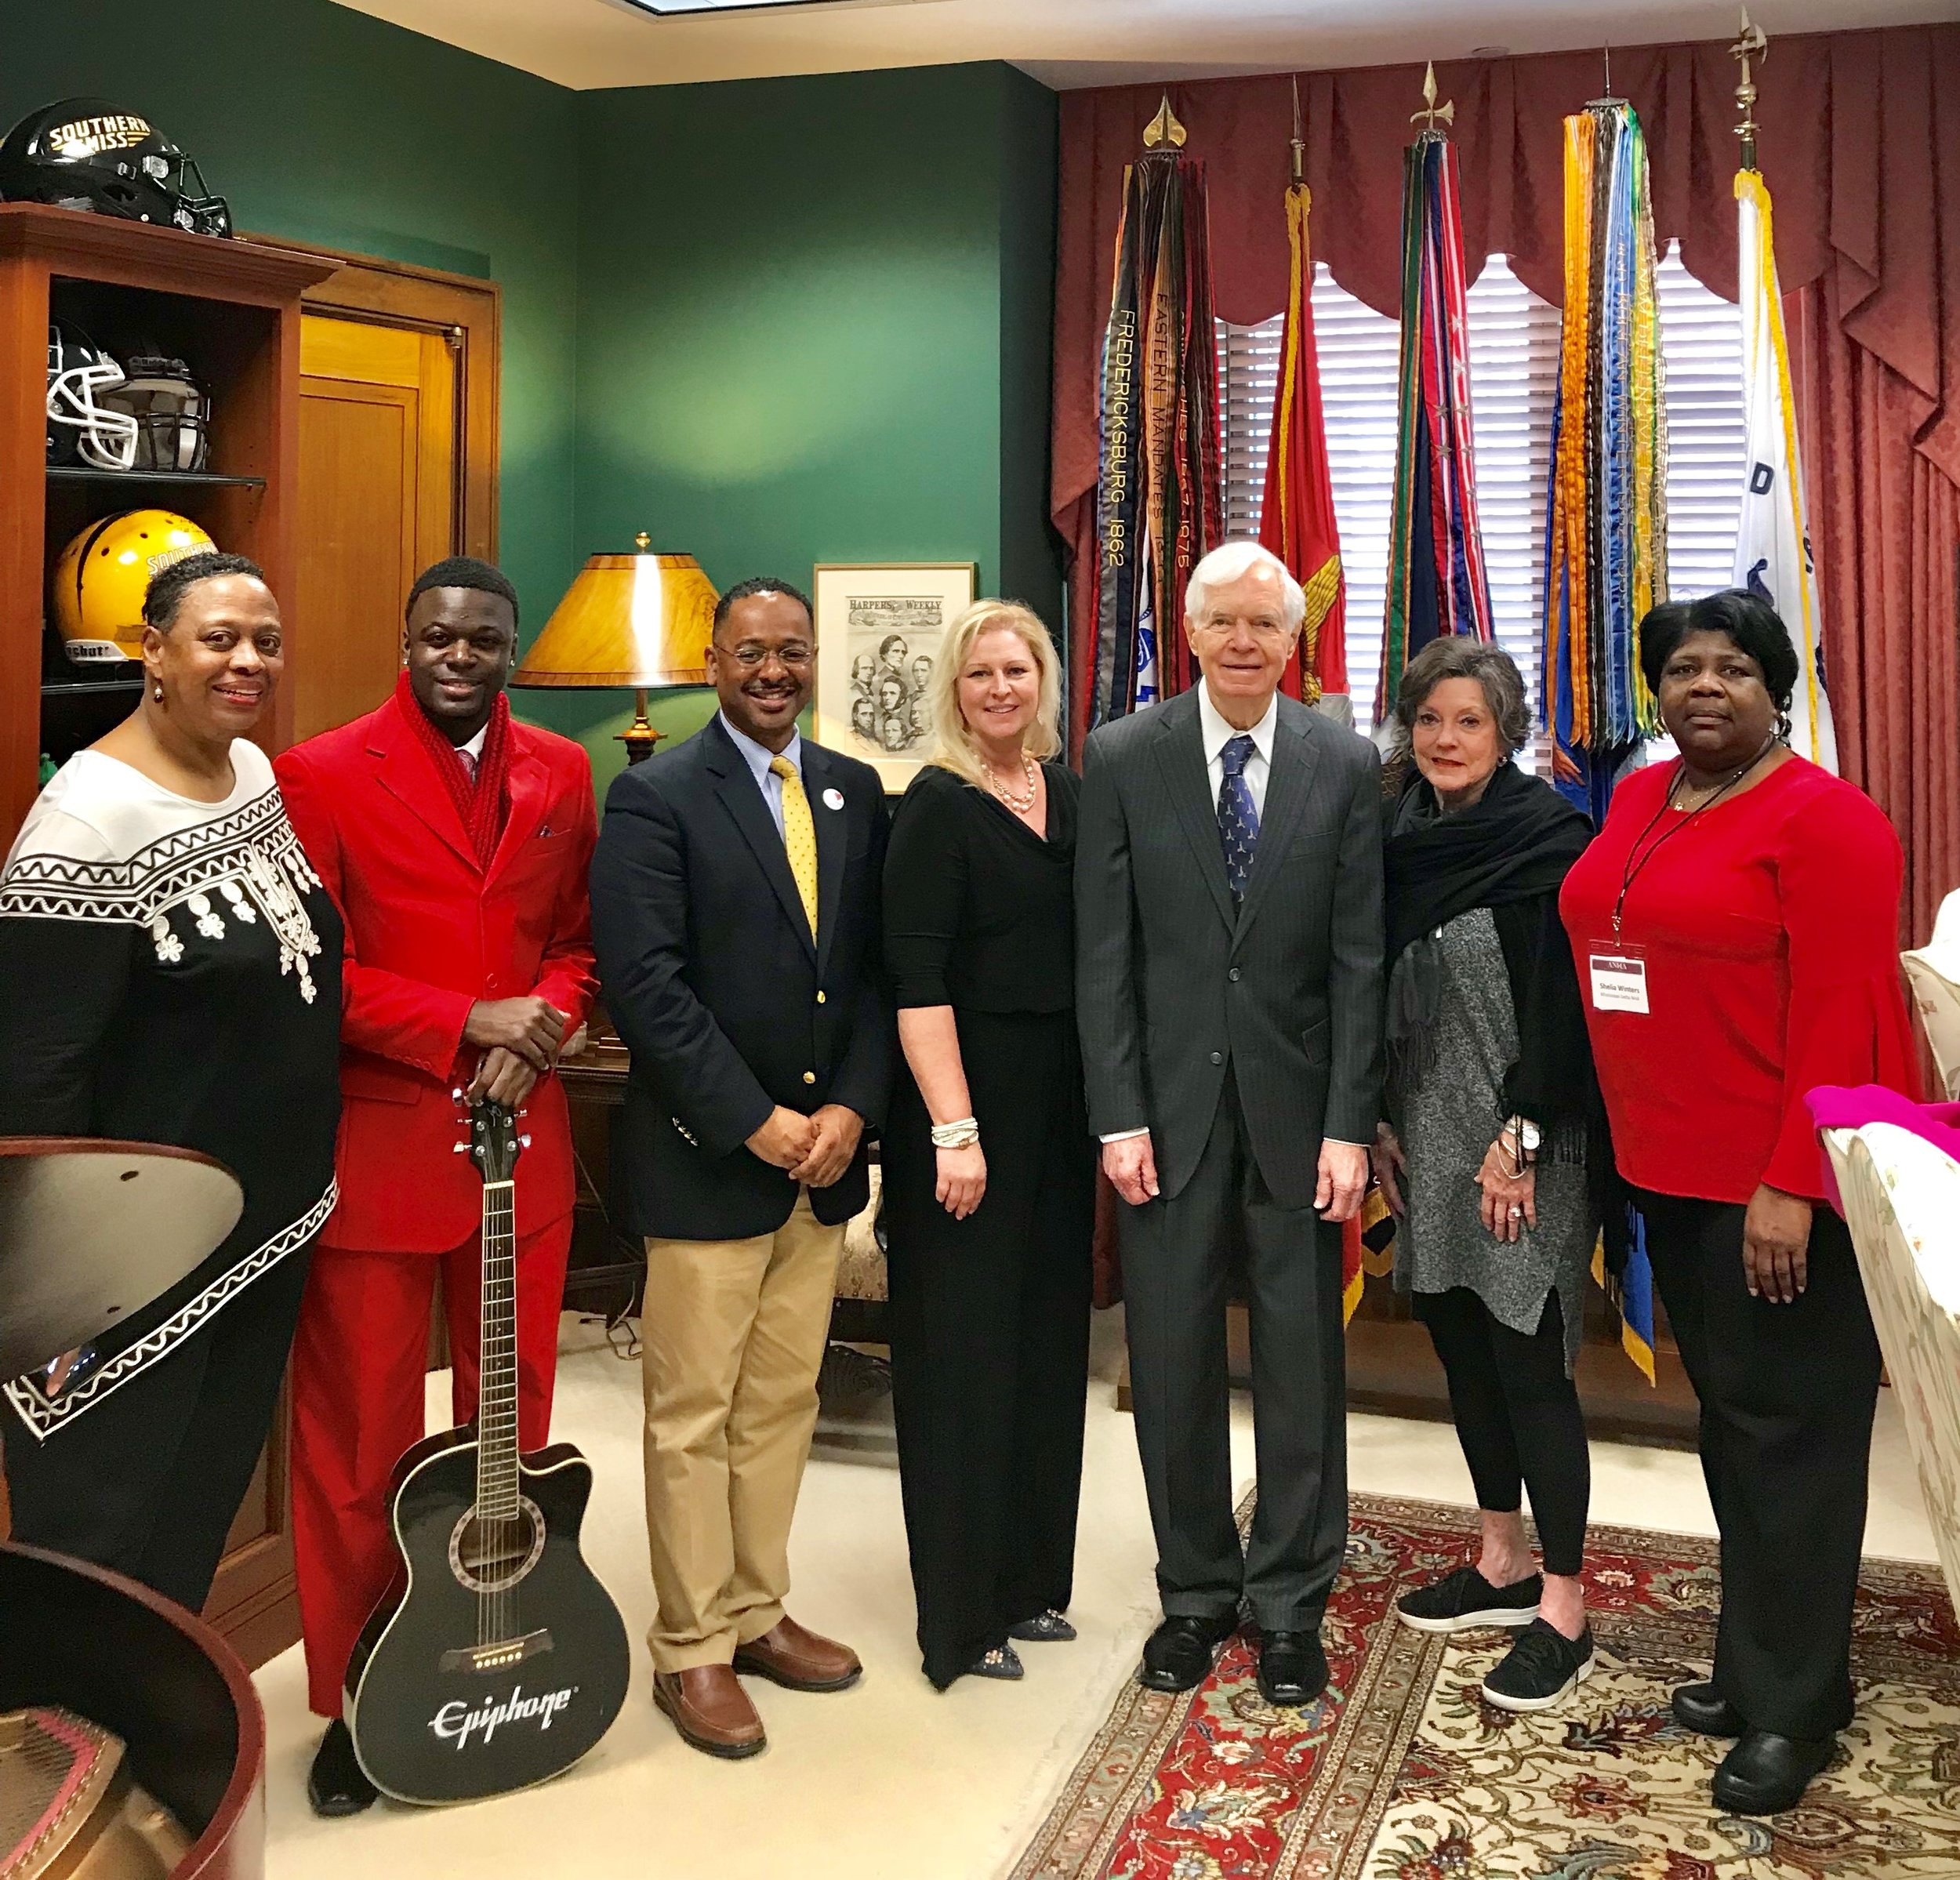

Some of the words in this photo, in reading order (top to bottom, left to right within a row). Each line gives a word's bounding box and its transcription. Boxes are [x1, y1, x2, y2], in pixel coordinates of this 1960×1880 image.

[49, 115, 151, 145] SOUTHERN
[82, 132, 128, 154] MISS
[1152, 292, 1168, 392] EASTERN
[1109, 310, 1135, 503] FREDERICKSBURG
[1152, 407, 1166, 519] MANDATES
[1109, 519, 1125, 566] 1862
[906, 600, 942, 610] WEEKLY
[427, 1686, 572, 1751] Epiphone
